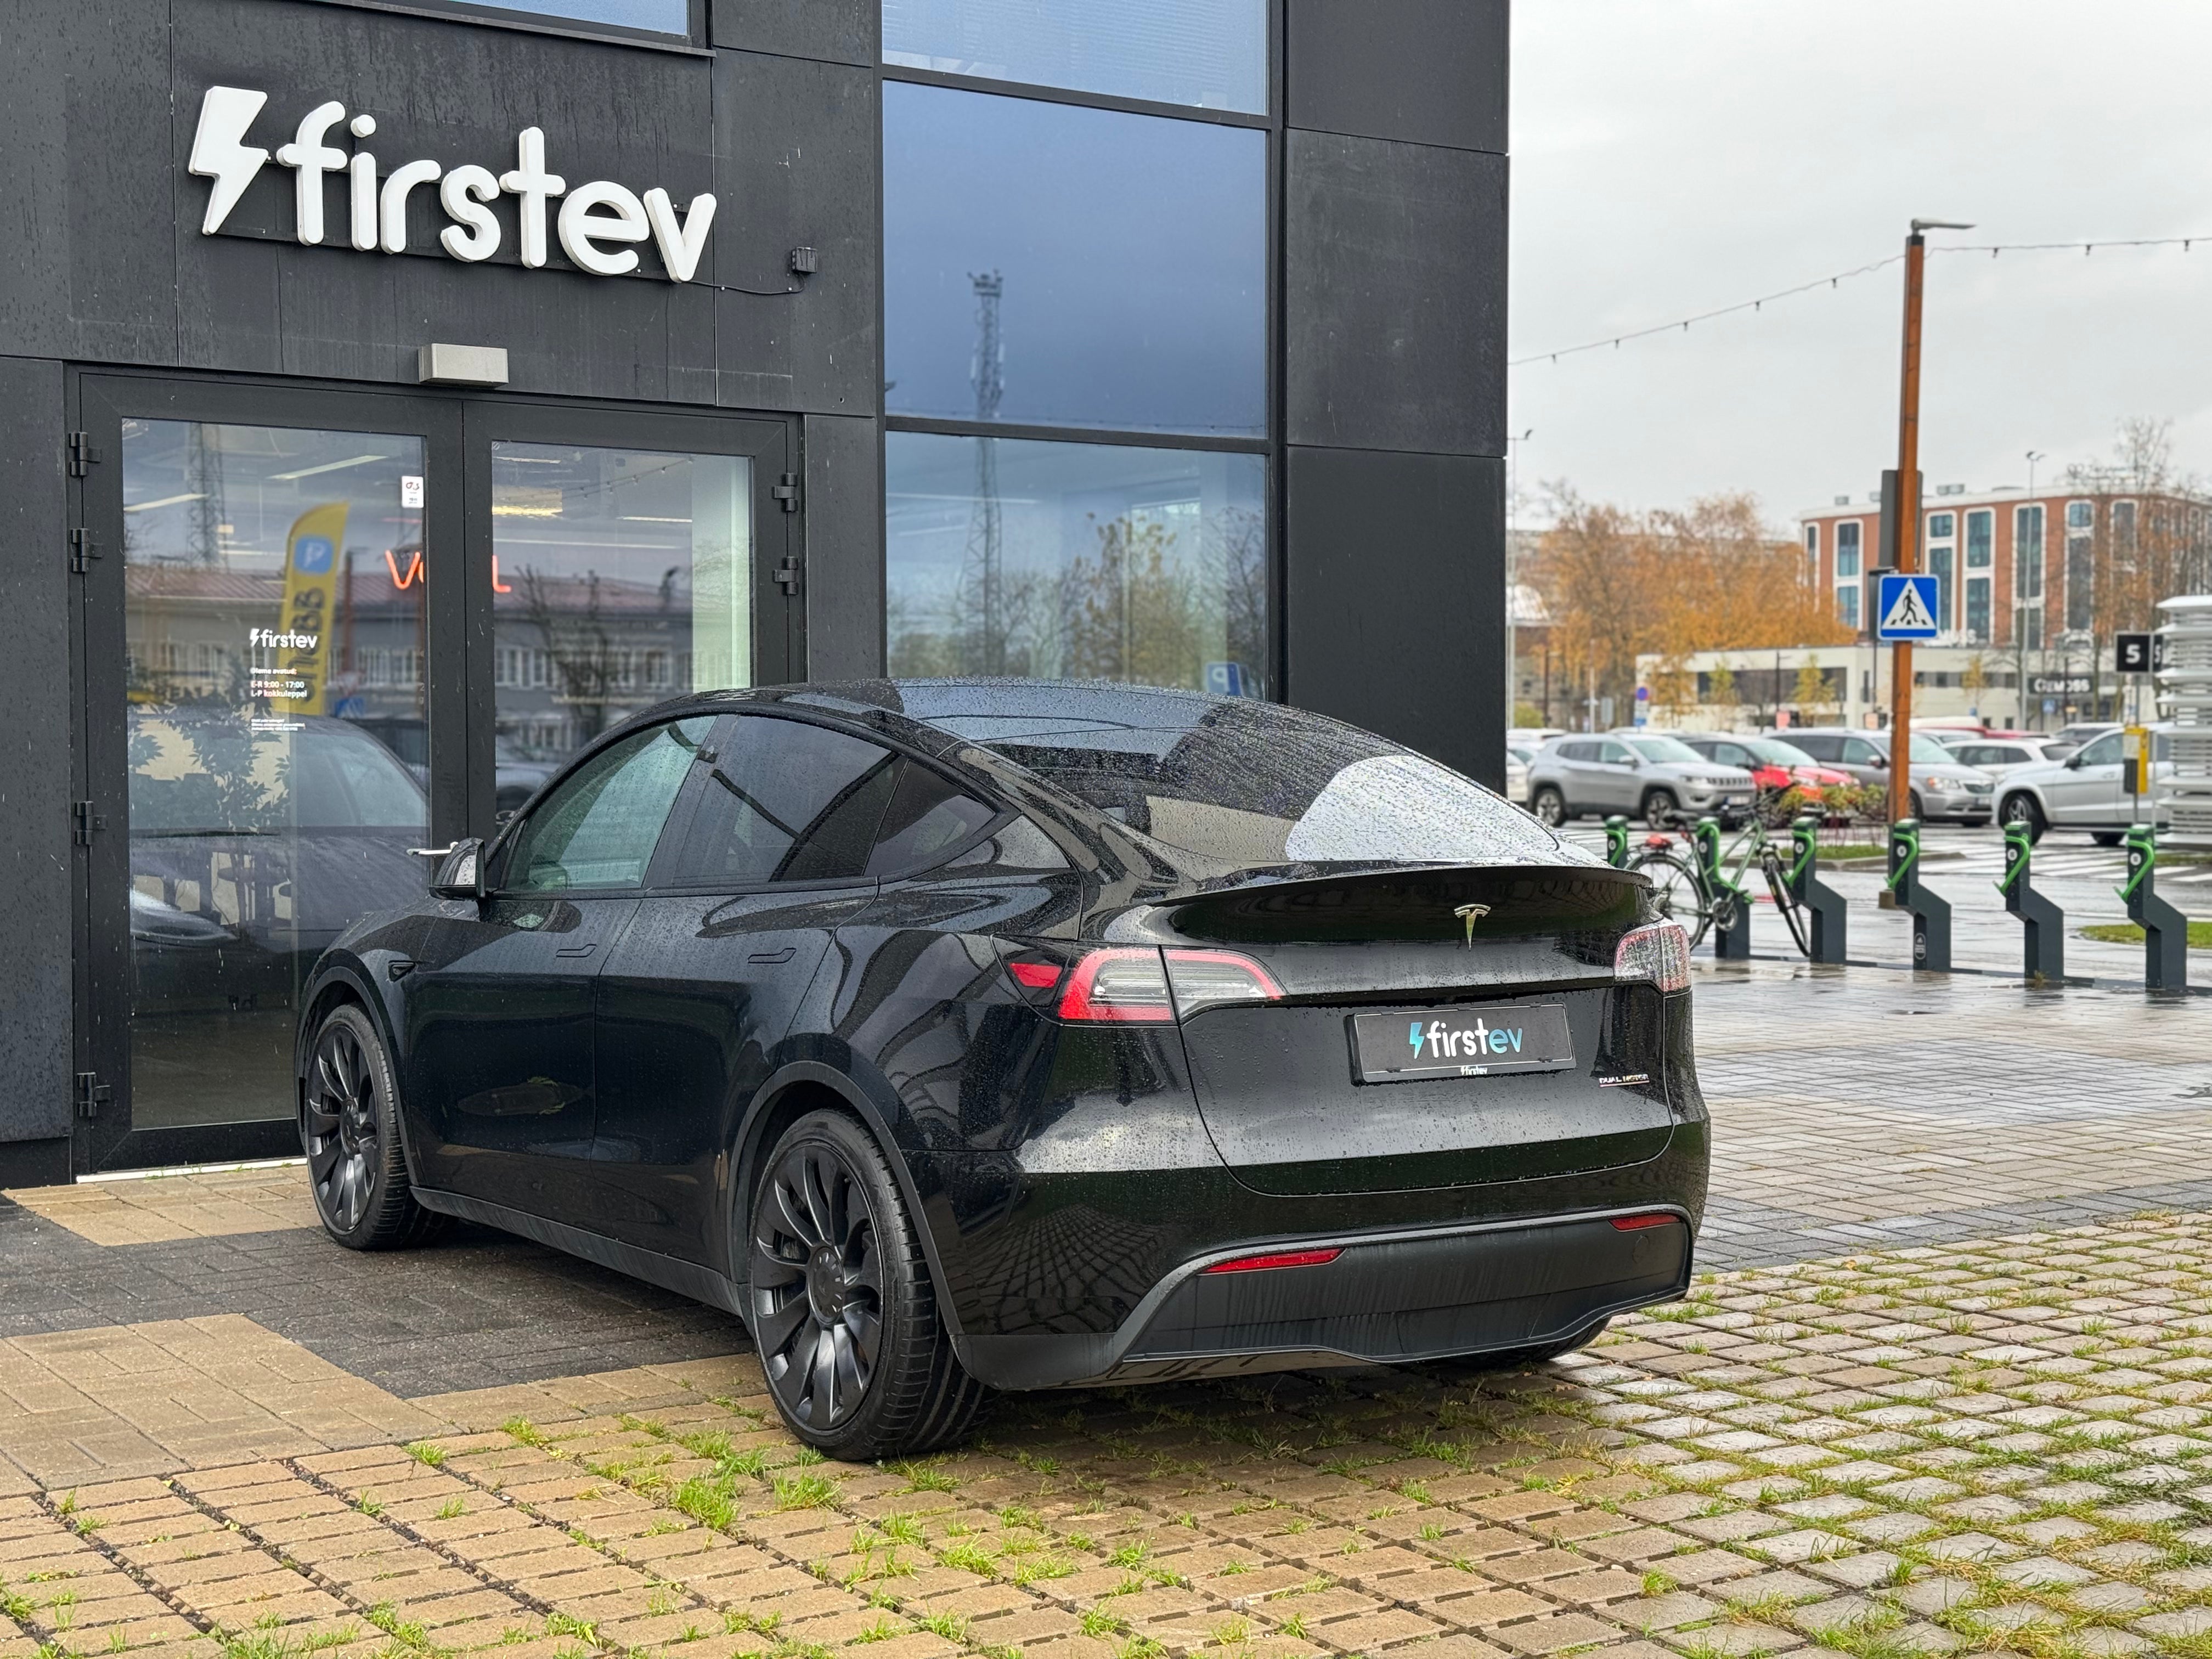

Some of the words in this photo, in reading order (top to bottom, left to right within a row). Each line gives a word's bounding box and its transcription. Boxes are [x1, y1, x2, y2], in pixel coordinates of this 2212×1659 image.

[276, 100, 716, 283] firstev
[260, 629, 318, 648] firstev
[1426, 1018, 1522, 1058] firstev
